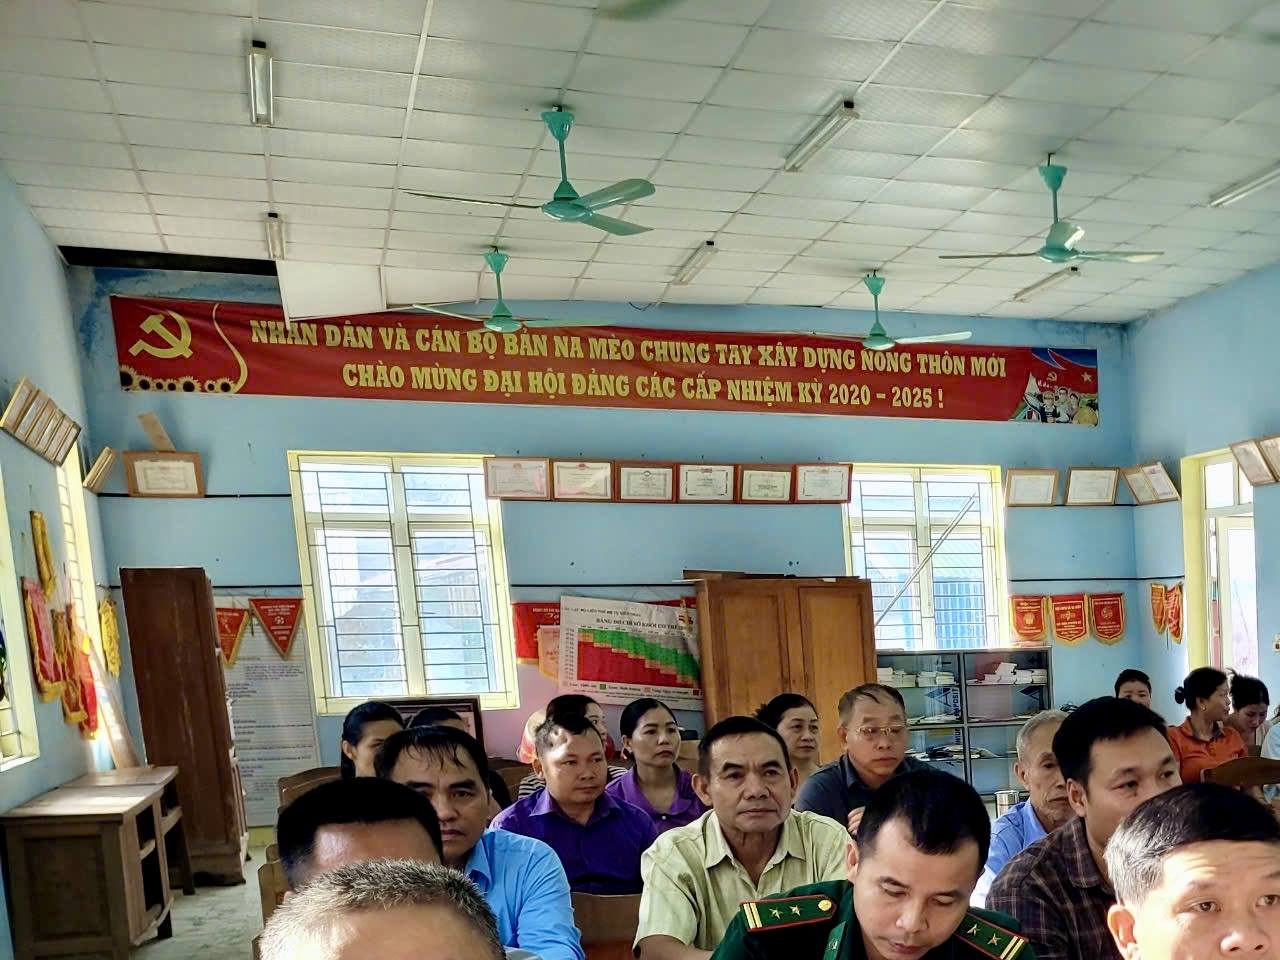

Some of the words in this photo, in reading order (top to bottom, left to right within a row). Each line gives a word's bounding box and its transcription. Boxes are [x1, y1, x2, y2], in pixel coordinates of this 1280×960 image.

[323, 320, 374, 349] DÂN
[378, 322, 411, 351] VÀ
[415, 324, 462, 353] CÁN
[503, 328, 548, 357] BẢN
[553, 335, 584, 359] NA
[588, 334, 635, 361] MÈO
[640, 340, 711, 364] CHUNG
[715, 343, 753, 367] TAY
[757, 342, 798, 368] XÂY
[803, 346, 856, 374] DỰNG
[917, 350, 965, 376] THÔN
[970, 352, 1007, 378] MỚI
[342, 360, 405, 389] CHÀO
[410, 362, 478, 392] MỪNG
[483, 369, 523, 398] ĐẠI
[527, 367, 567, 400] HỘI
[571, 367, 630, 397] ĐẢNG
[635, 370, 677, 399] CÁC
[681, 369, 722, 400] CẤP
[727, 376, 793, 407] NHIỆM
[798, 378, 824, 405] KỲ
[828, 383, 871, 406] 2020
[892, 387, 933, 409] 2025
